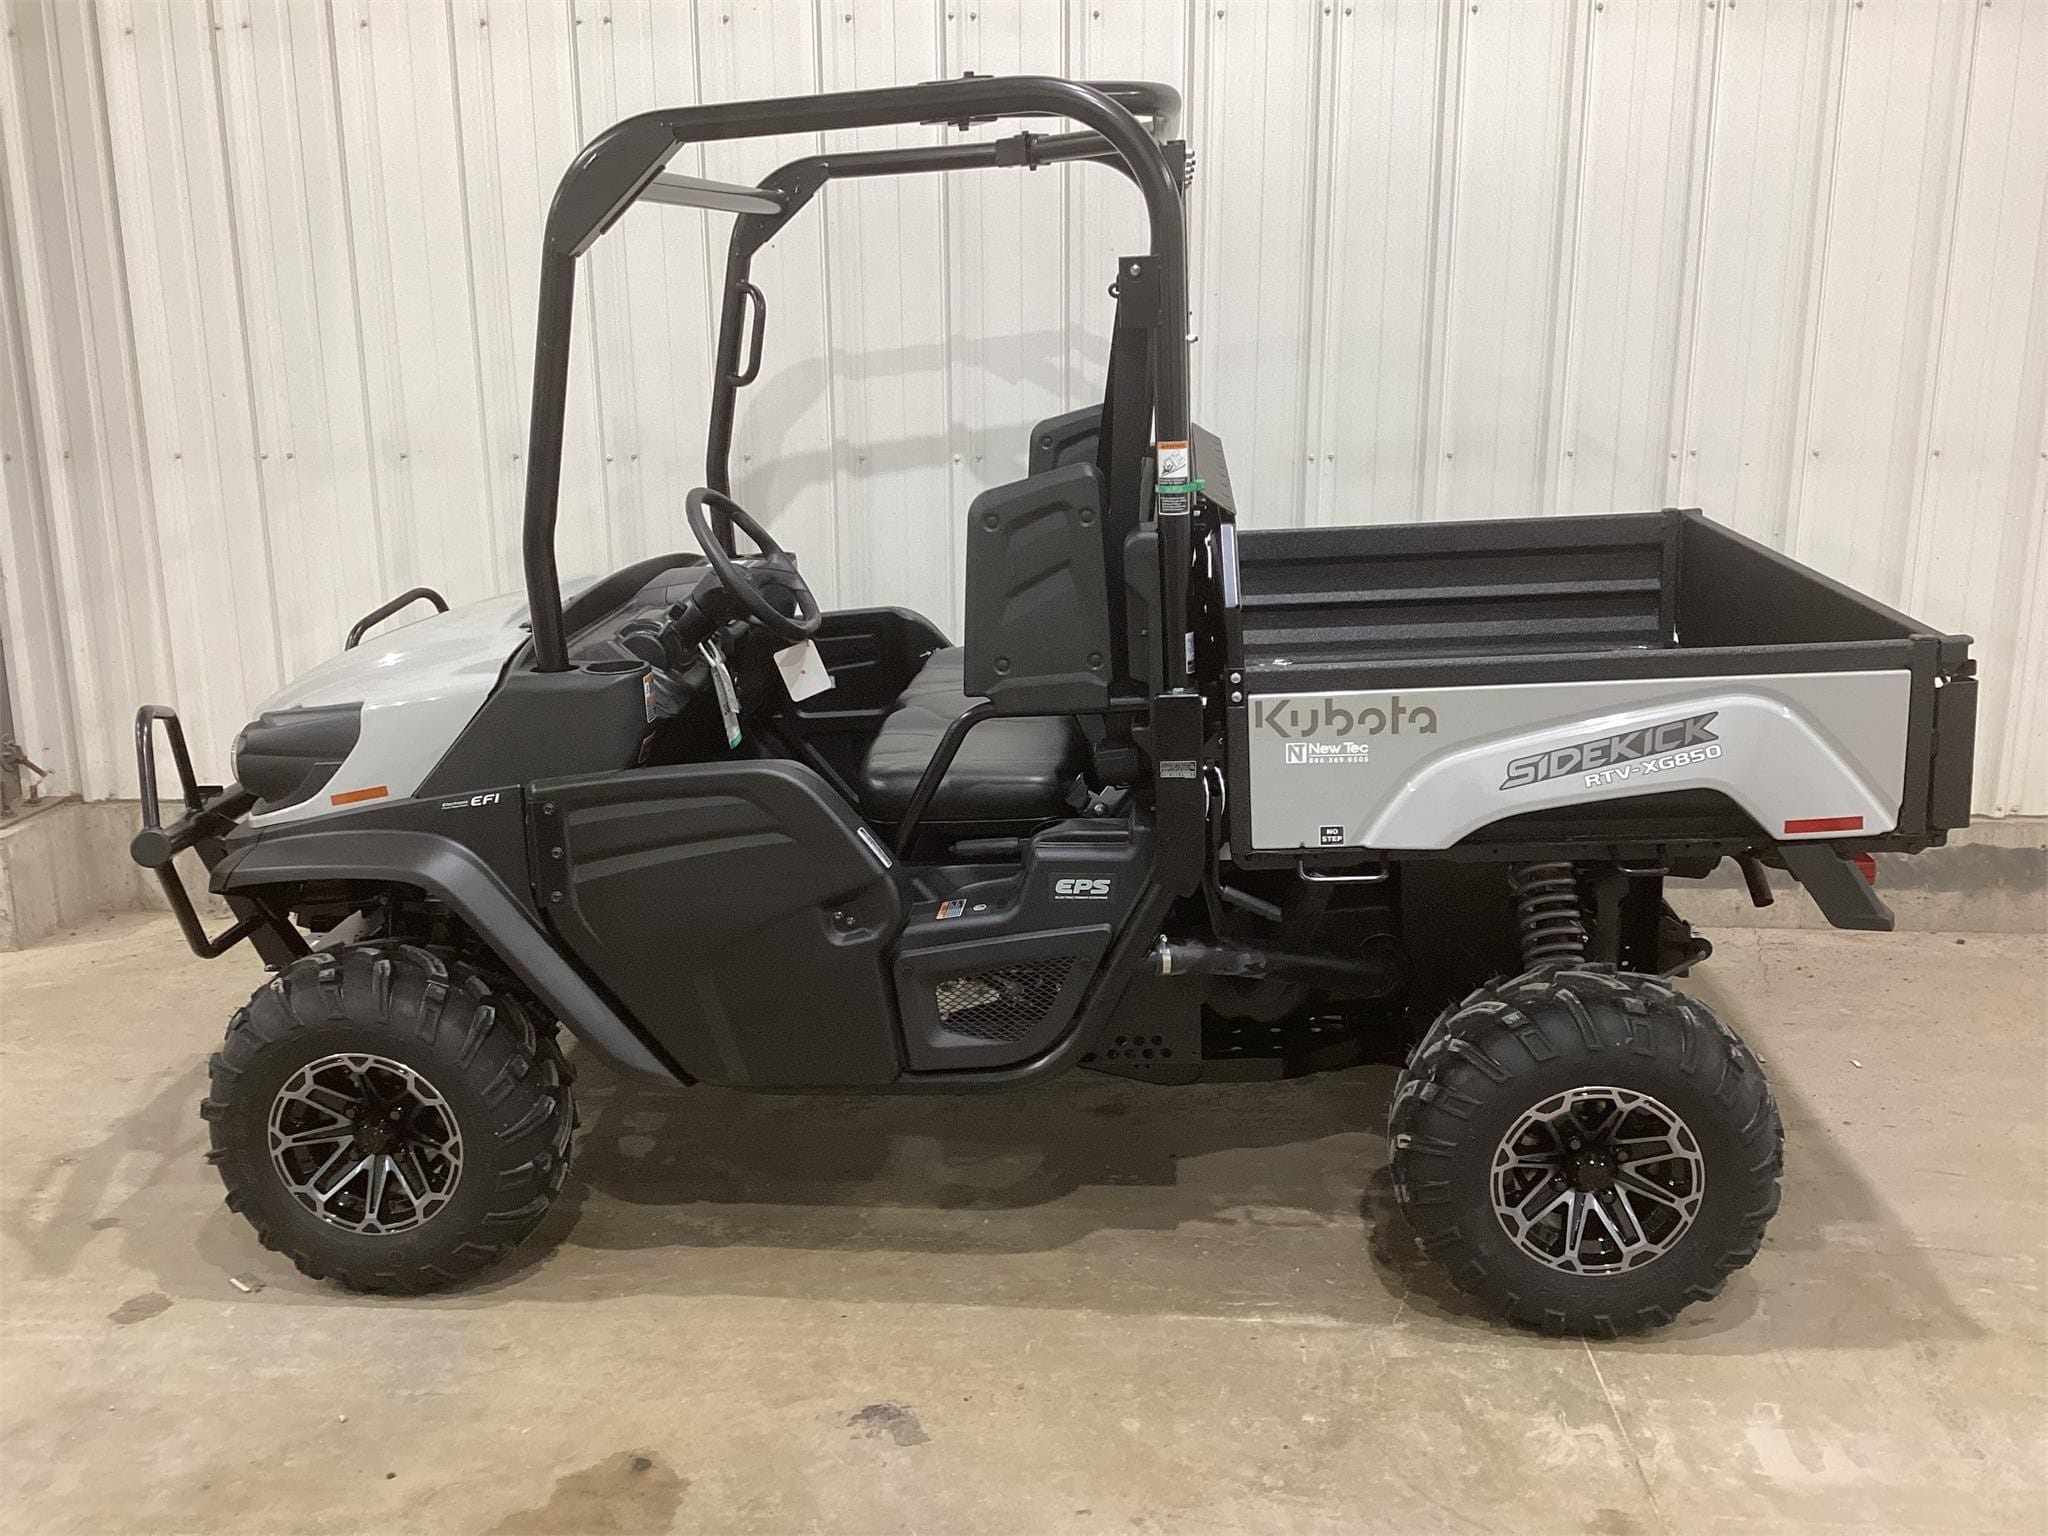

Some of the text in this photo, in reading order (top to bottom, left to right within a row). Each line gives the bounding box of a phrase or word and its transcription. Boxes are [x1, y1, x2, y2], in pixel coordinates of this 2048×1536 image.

[1255, 696, 1437, 738] Kubota
[1309, 742, 1369, 754] New Tec
[1499, 711, 1719, 790] SIDEKICK
[1584, 744, 1722, 788] RTV-XG850
[471, 793, 500, 807] EFI
[1055, 879, 1111, 894] EPS
